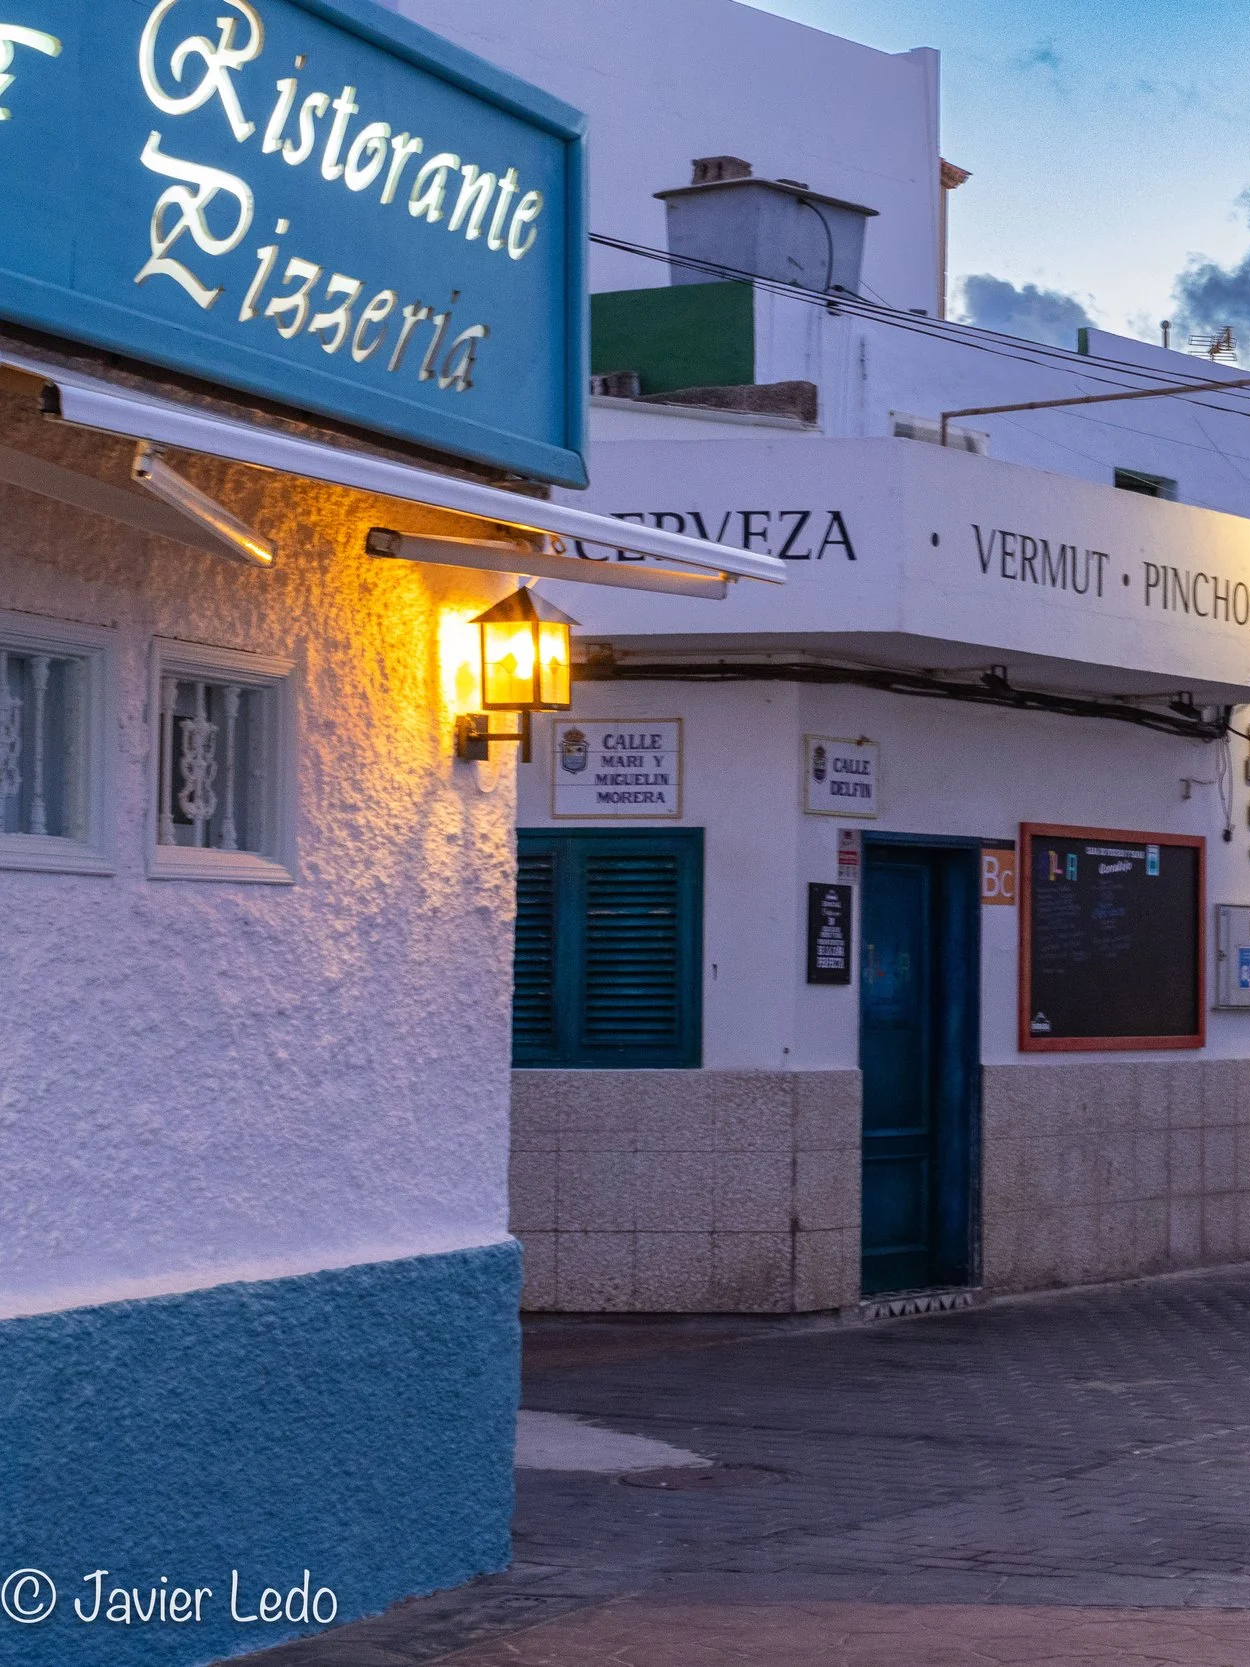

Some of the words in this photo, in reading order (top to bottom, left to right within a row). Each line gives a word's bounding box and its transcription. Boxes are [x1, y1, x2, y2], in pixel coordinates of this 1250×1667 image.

[139, 0, 544, 261] Ristorante
[134, 131, 490, 393] Pizzeria
[971, 524, 1110, 598] VERMUT
[602, 733, 662, 750] CALLE
[600, 755, 645, 768] MARI
[653, 755, 665, 768] Y
[832, 757, 871, 776] CALLE
[595, 773, 670, 786] MIGUELIN
[596, 791, 666, 804] MORERA
[981, 855, 1013, 898] Bc
